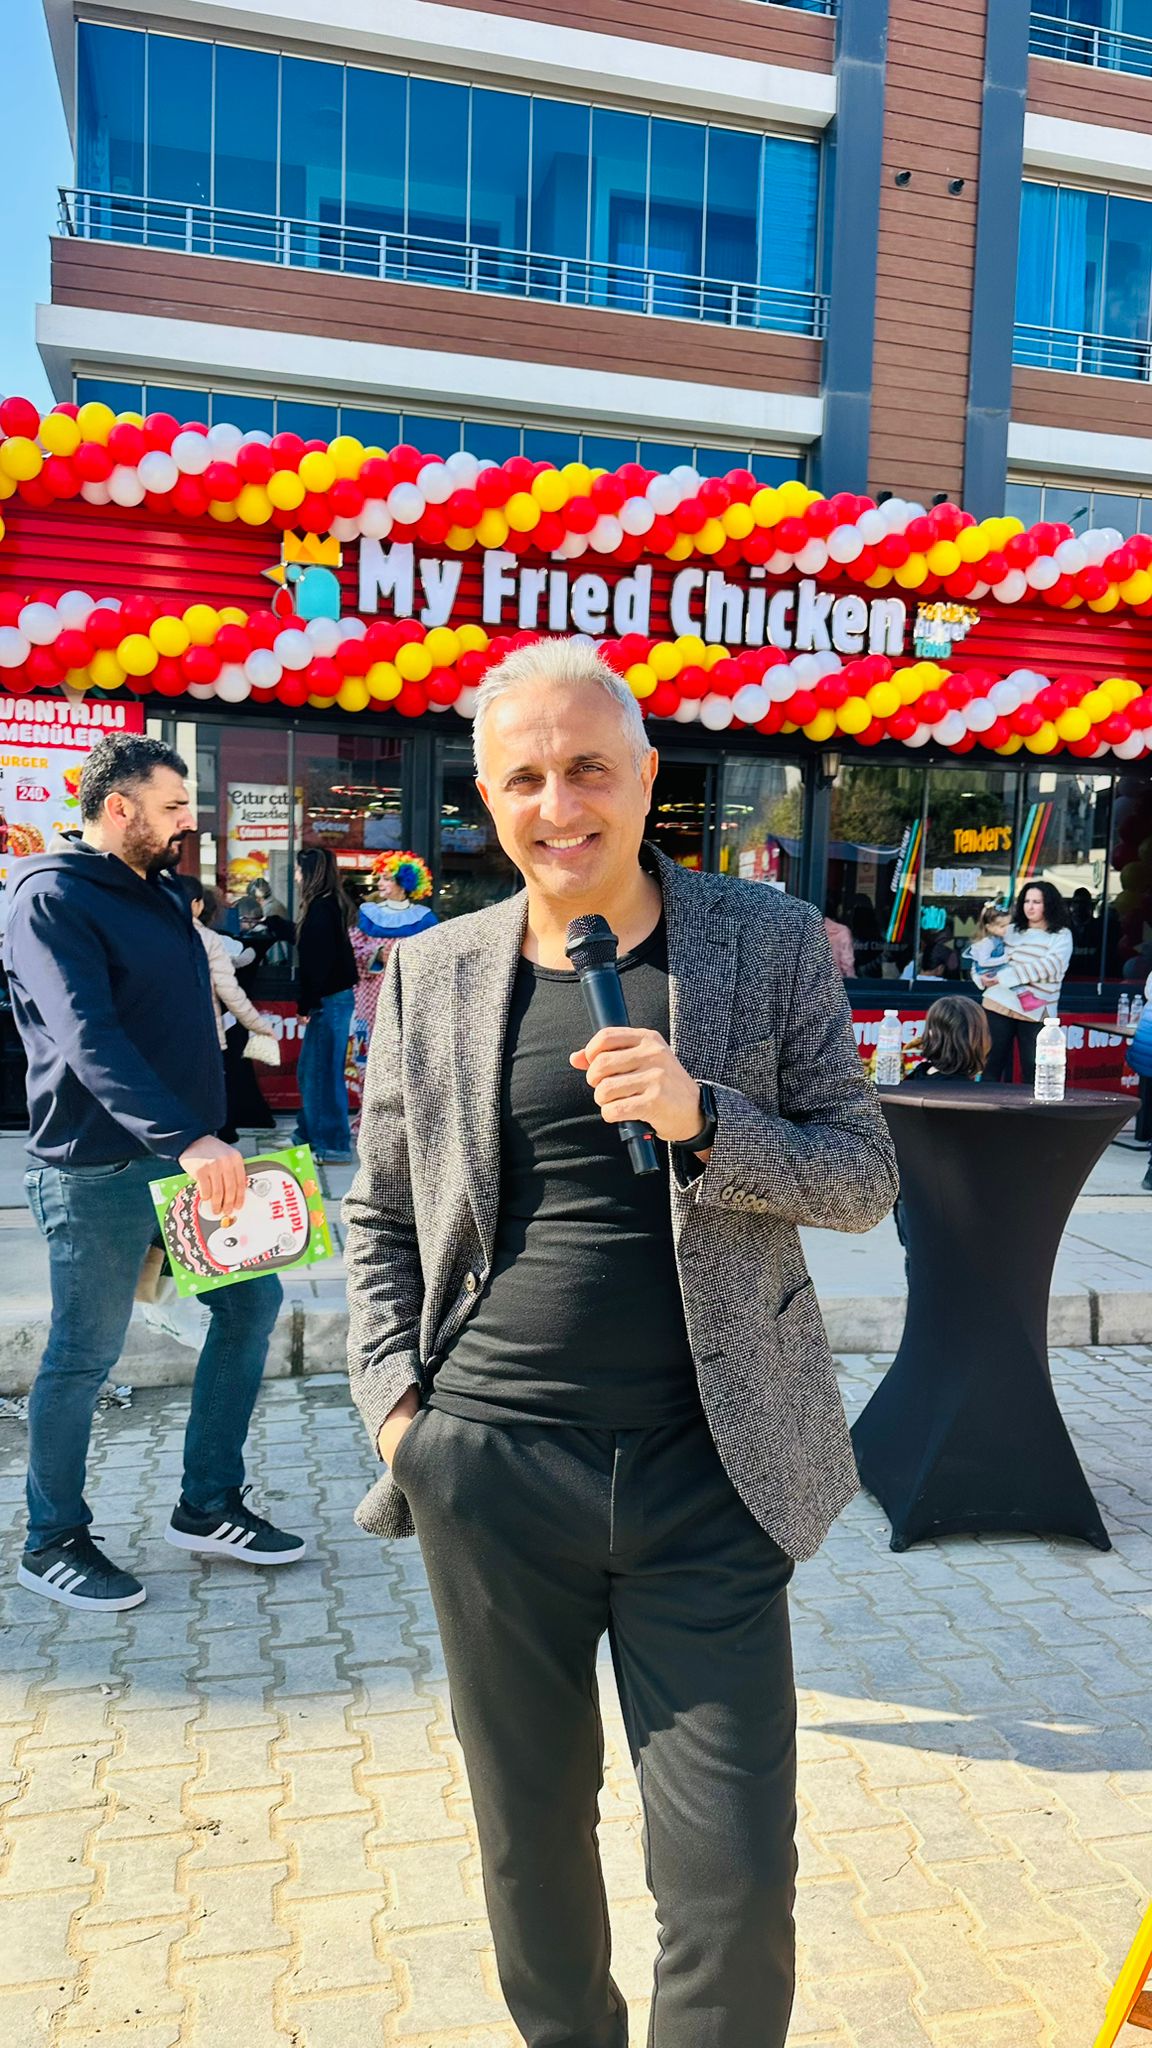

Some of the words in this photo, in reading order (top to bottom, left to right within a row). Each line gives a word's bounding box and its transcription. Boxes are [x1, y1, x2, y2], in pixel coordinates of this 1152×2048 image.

[358, 537, 463, 628] My
[482, 549, 653, 637] Fried
[669, 566, 907, 657] Chicken
[0, 756, 48, 769] URGER
[18, 786, 44, 801] 240
[953, 824, 1012, 854] Tenders
